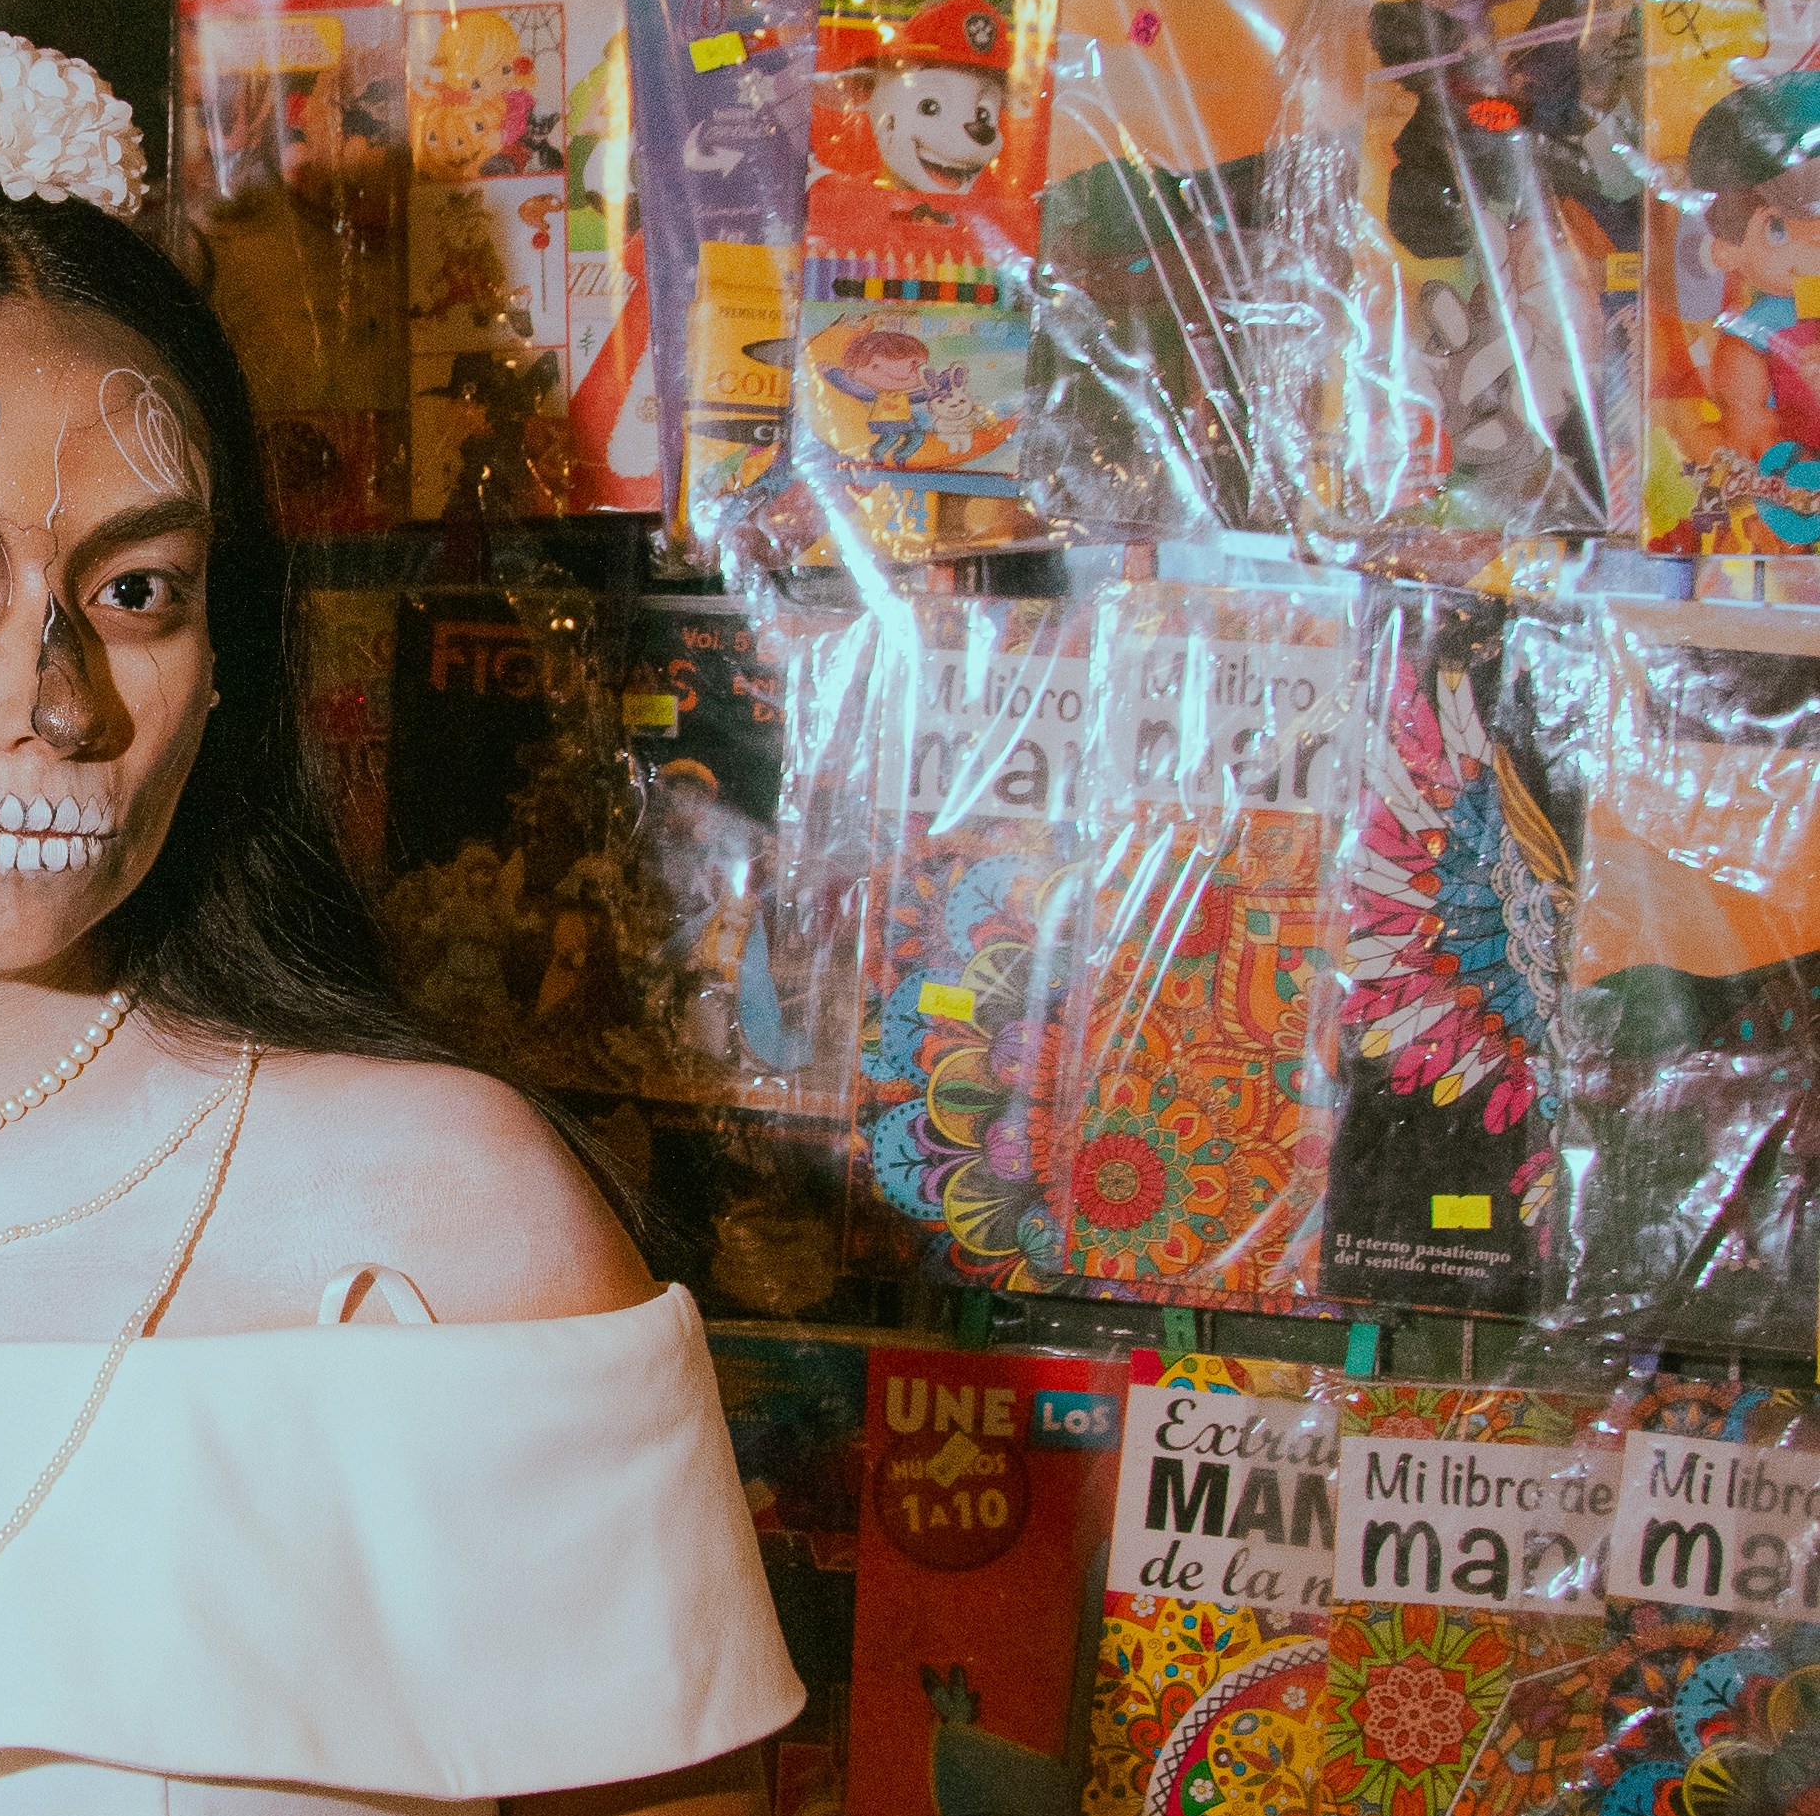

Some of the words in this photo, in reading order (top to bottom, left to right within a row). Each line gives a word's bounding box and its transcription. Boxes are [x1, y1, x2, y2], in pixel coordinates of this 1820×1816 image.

[1334, 1250, 1361, 1266] del
[1366, 1255, 1426, 1272] sentido
[1335, 1233, 1351, 1248] El
[1356, 1238, 1411, 1255] eterno
[1415, 1243, 1513, 1266] pasatiempo
[886, 1376, 1017, 1438] UNE
[1043, 1402, 1111, 1435] LOS
[1366, 1451, 1427, 1505] Mi
[1440, 1454, 1544, 1512] libro
[1649, 1449, 1715, 1505] Mi
[901, 1493, 922, 1532] 1
[930, 1505, 950, 1528] A
[953, 1487, 1010, 1530] 10
[1140, 1539, 1205, 1593] de
[1221, 1545, 1286, 1602] la
